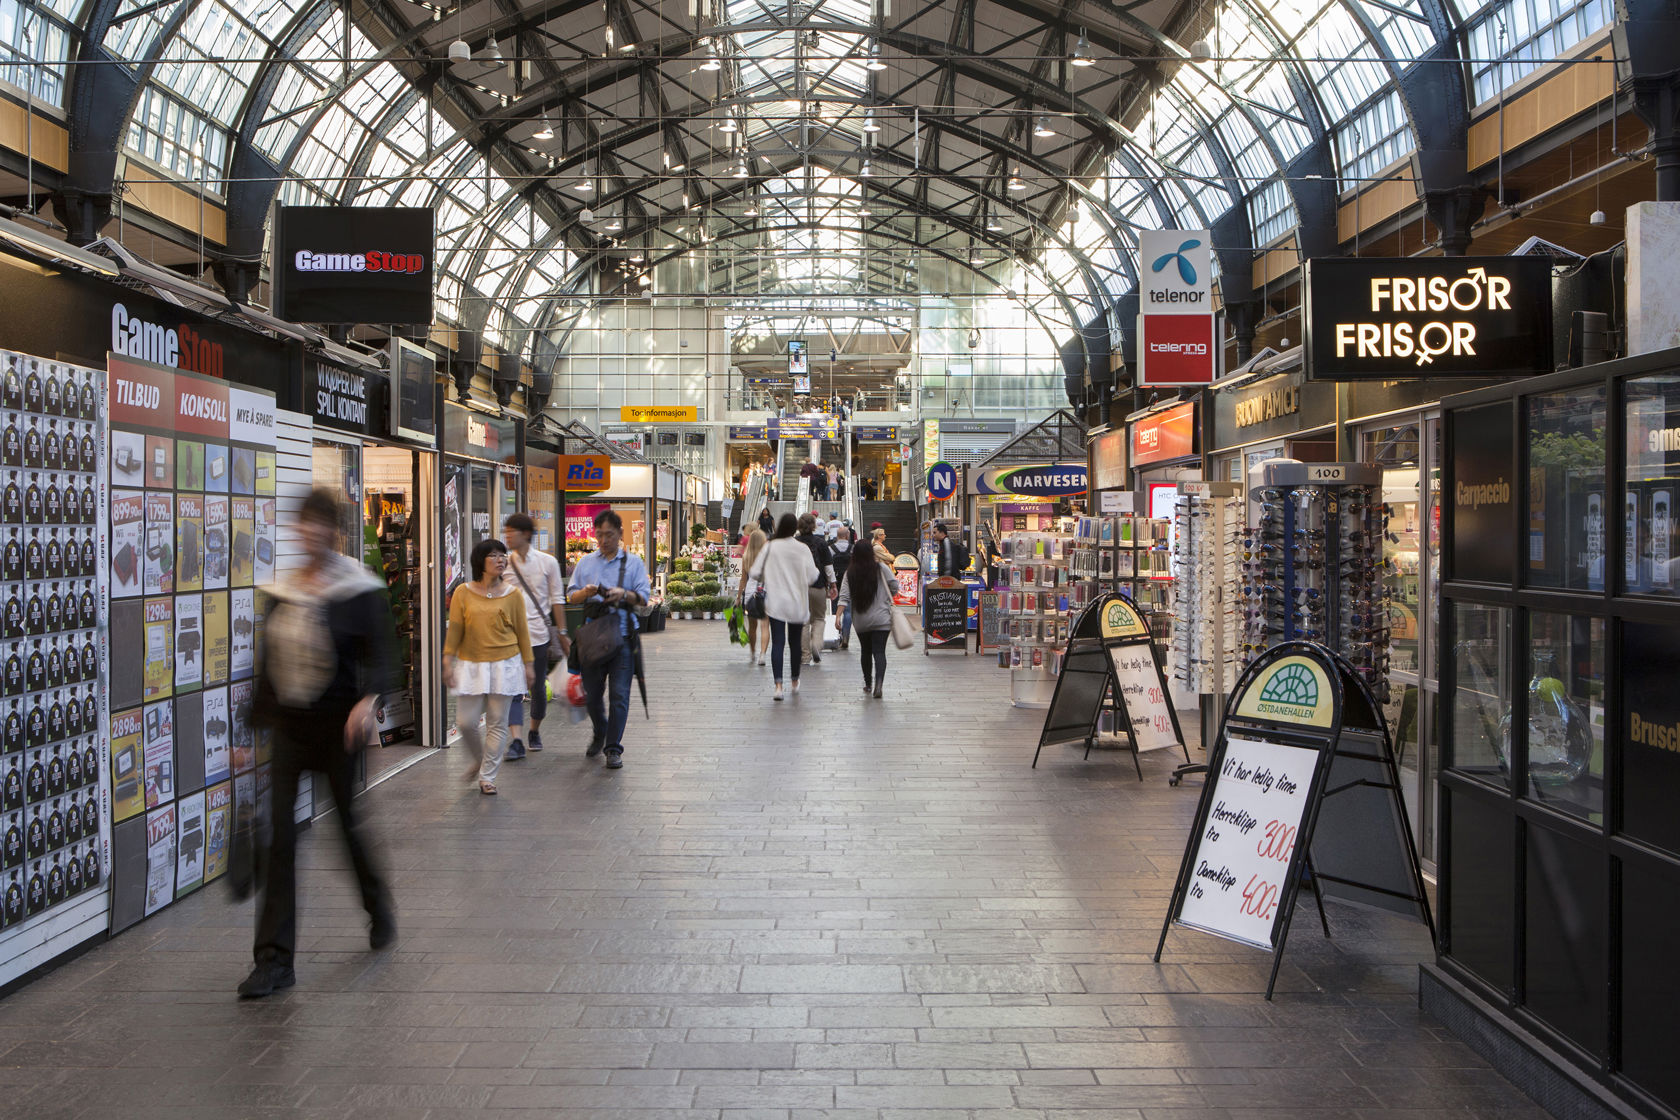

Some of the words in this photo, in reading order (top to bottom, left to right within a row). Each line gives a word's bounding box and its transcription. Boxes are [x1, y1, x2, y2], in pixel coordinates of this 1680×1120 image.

[295, 250, 424, 274] GameStop
[1150, 288, 1204, 303] telenor
[112, 302, 224, 378] GameStop
[1150, 342, 1206, 354] telering
[116, 378, 160, 410] TILBUD
[316, 362, 324, 386] VI
[325, 364, 350, 394] KJØPER
[350, 372, 366, 399] DINE
[180, 392, 226, 422] KONSOLL
[236, 408, 249, 422] MYE
[250, 408, 255, 424] Å
[255, 412, 274, 428] SPARE!
[317, 390, 336, 418] SPILL
[338, 396, 367, 424] KONTANT
[631, 409, 686, 418] Toginformasjon
[1236, 394, 1263, 428] BUONI
[567, 458, 604, 480] Ria
[934, 472, 951, 490] N
[1013, 474, 1088, 488] NARVESEN
[1316, 469, 1340, 478] 100
[1456, 477, 1510, 510] Carpaccio
[1258, 704, 1314, 719] ØSTBANEHALLEN
[1223, 758, 1236, 776] Vi
[1251, 766, 1274, 794] ledig
[1276, 773, 1296, 794] time
[1212, 800, 1257, 835] Herreklipp
[1197, 860, 1236, 892] Dameklipp
